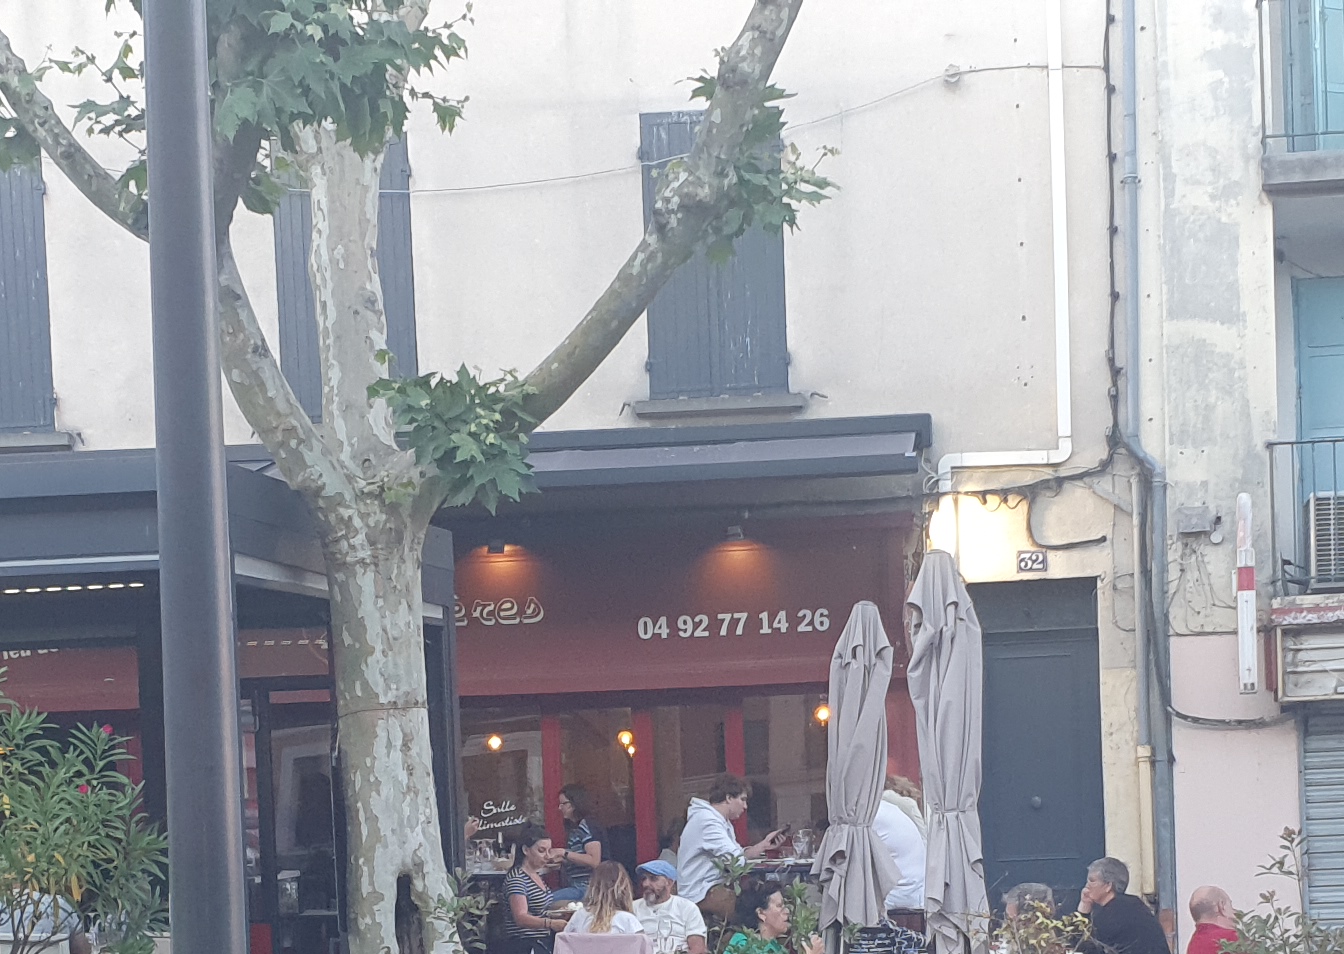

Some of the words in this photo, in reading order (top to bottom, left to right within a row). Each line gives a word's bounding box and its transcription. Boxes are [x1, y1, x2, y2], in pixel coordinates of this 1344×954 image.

[1020, 552, 1044, 570] 32
[637, 616, 670, 640] 04
[677, 614, 710, 638] 92
[717, 612, 749, 636] 77
[758, 610, 789, 634] 14
[796, 608, 830, 632] 26
[481, 800, 517, 818] Salle
